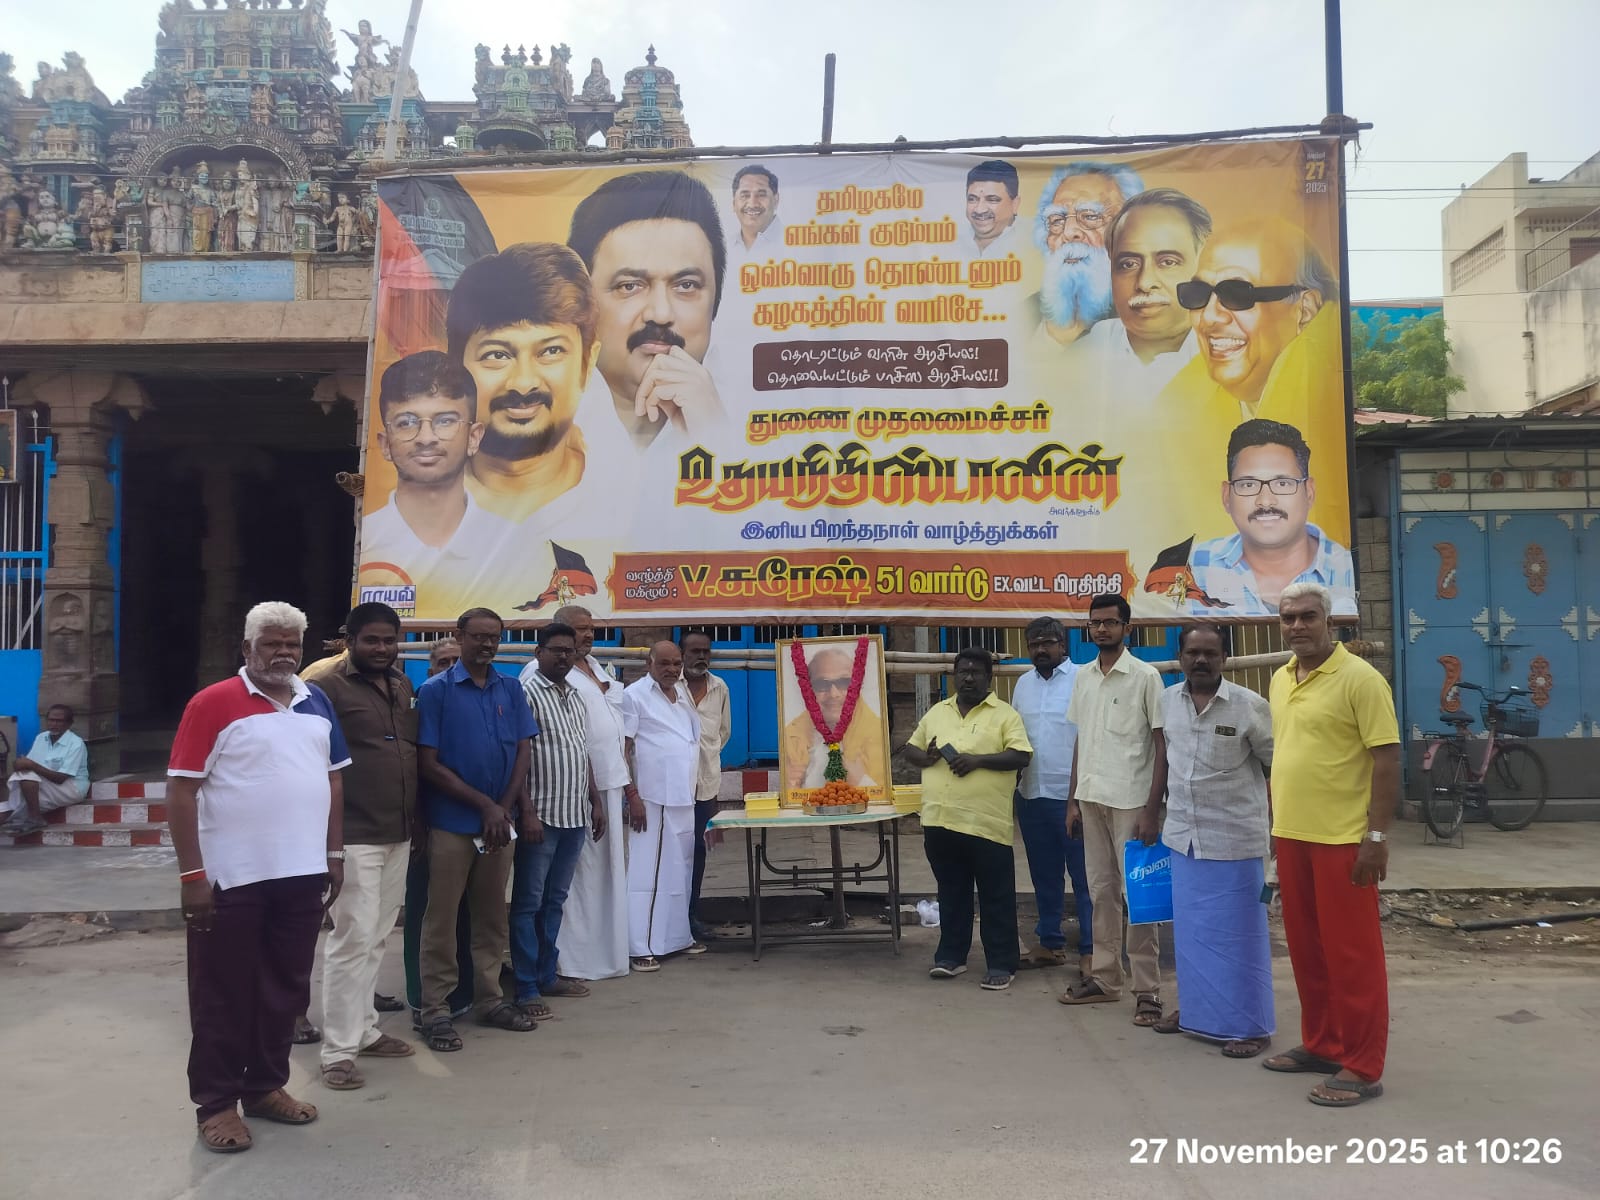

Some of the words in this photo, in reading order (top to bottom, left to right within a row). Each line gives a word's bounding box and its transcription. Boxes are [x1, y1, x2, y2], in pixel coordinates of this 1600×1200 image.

[1306, 161, 1325, 180] 27
[818, 184, 923, 214] தமிழகமே
[786, 219, 861, 246] எங்கள்
[871, 216, 956, 246] குடும்பம்
[740, 259, 854, 292] ஒவ்வொரு
[866, 253, 1021, 288] தொண்டனும்
[753, 293, 885, 330] கழகத்தின்
[781, 347, 862, 365] தொடரட்டும்
[867, 346, 908, 363] வாரிசு
[914, 343, 979, 365] அரசியல்!
[767, 368, 871, 388] தொலையட்டும்
[927, 365, 999, 387] அரசியல்!!
[749, 409, 851, 443] துணை
[857, 402, 1050, 441] முதலமைச்சர்
[741, 520, 806, 540] இனிய
[810, 518, 919, 542] பிறந்தநாள்
[924, 520, 1059, 545] வாழ்த்துக்கள்
[626, 566, 676, 585] வாழ்த்தி
[876, 566, 904, 593] 51
[909, 564, 988, 601] வார்டு
[1053, 573, 1122, 597] பிரதிநிதி
[361, 586, 414, 602] ராயல்
